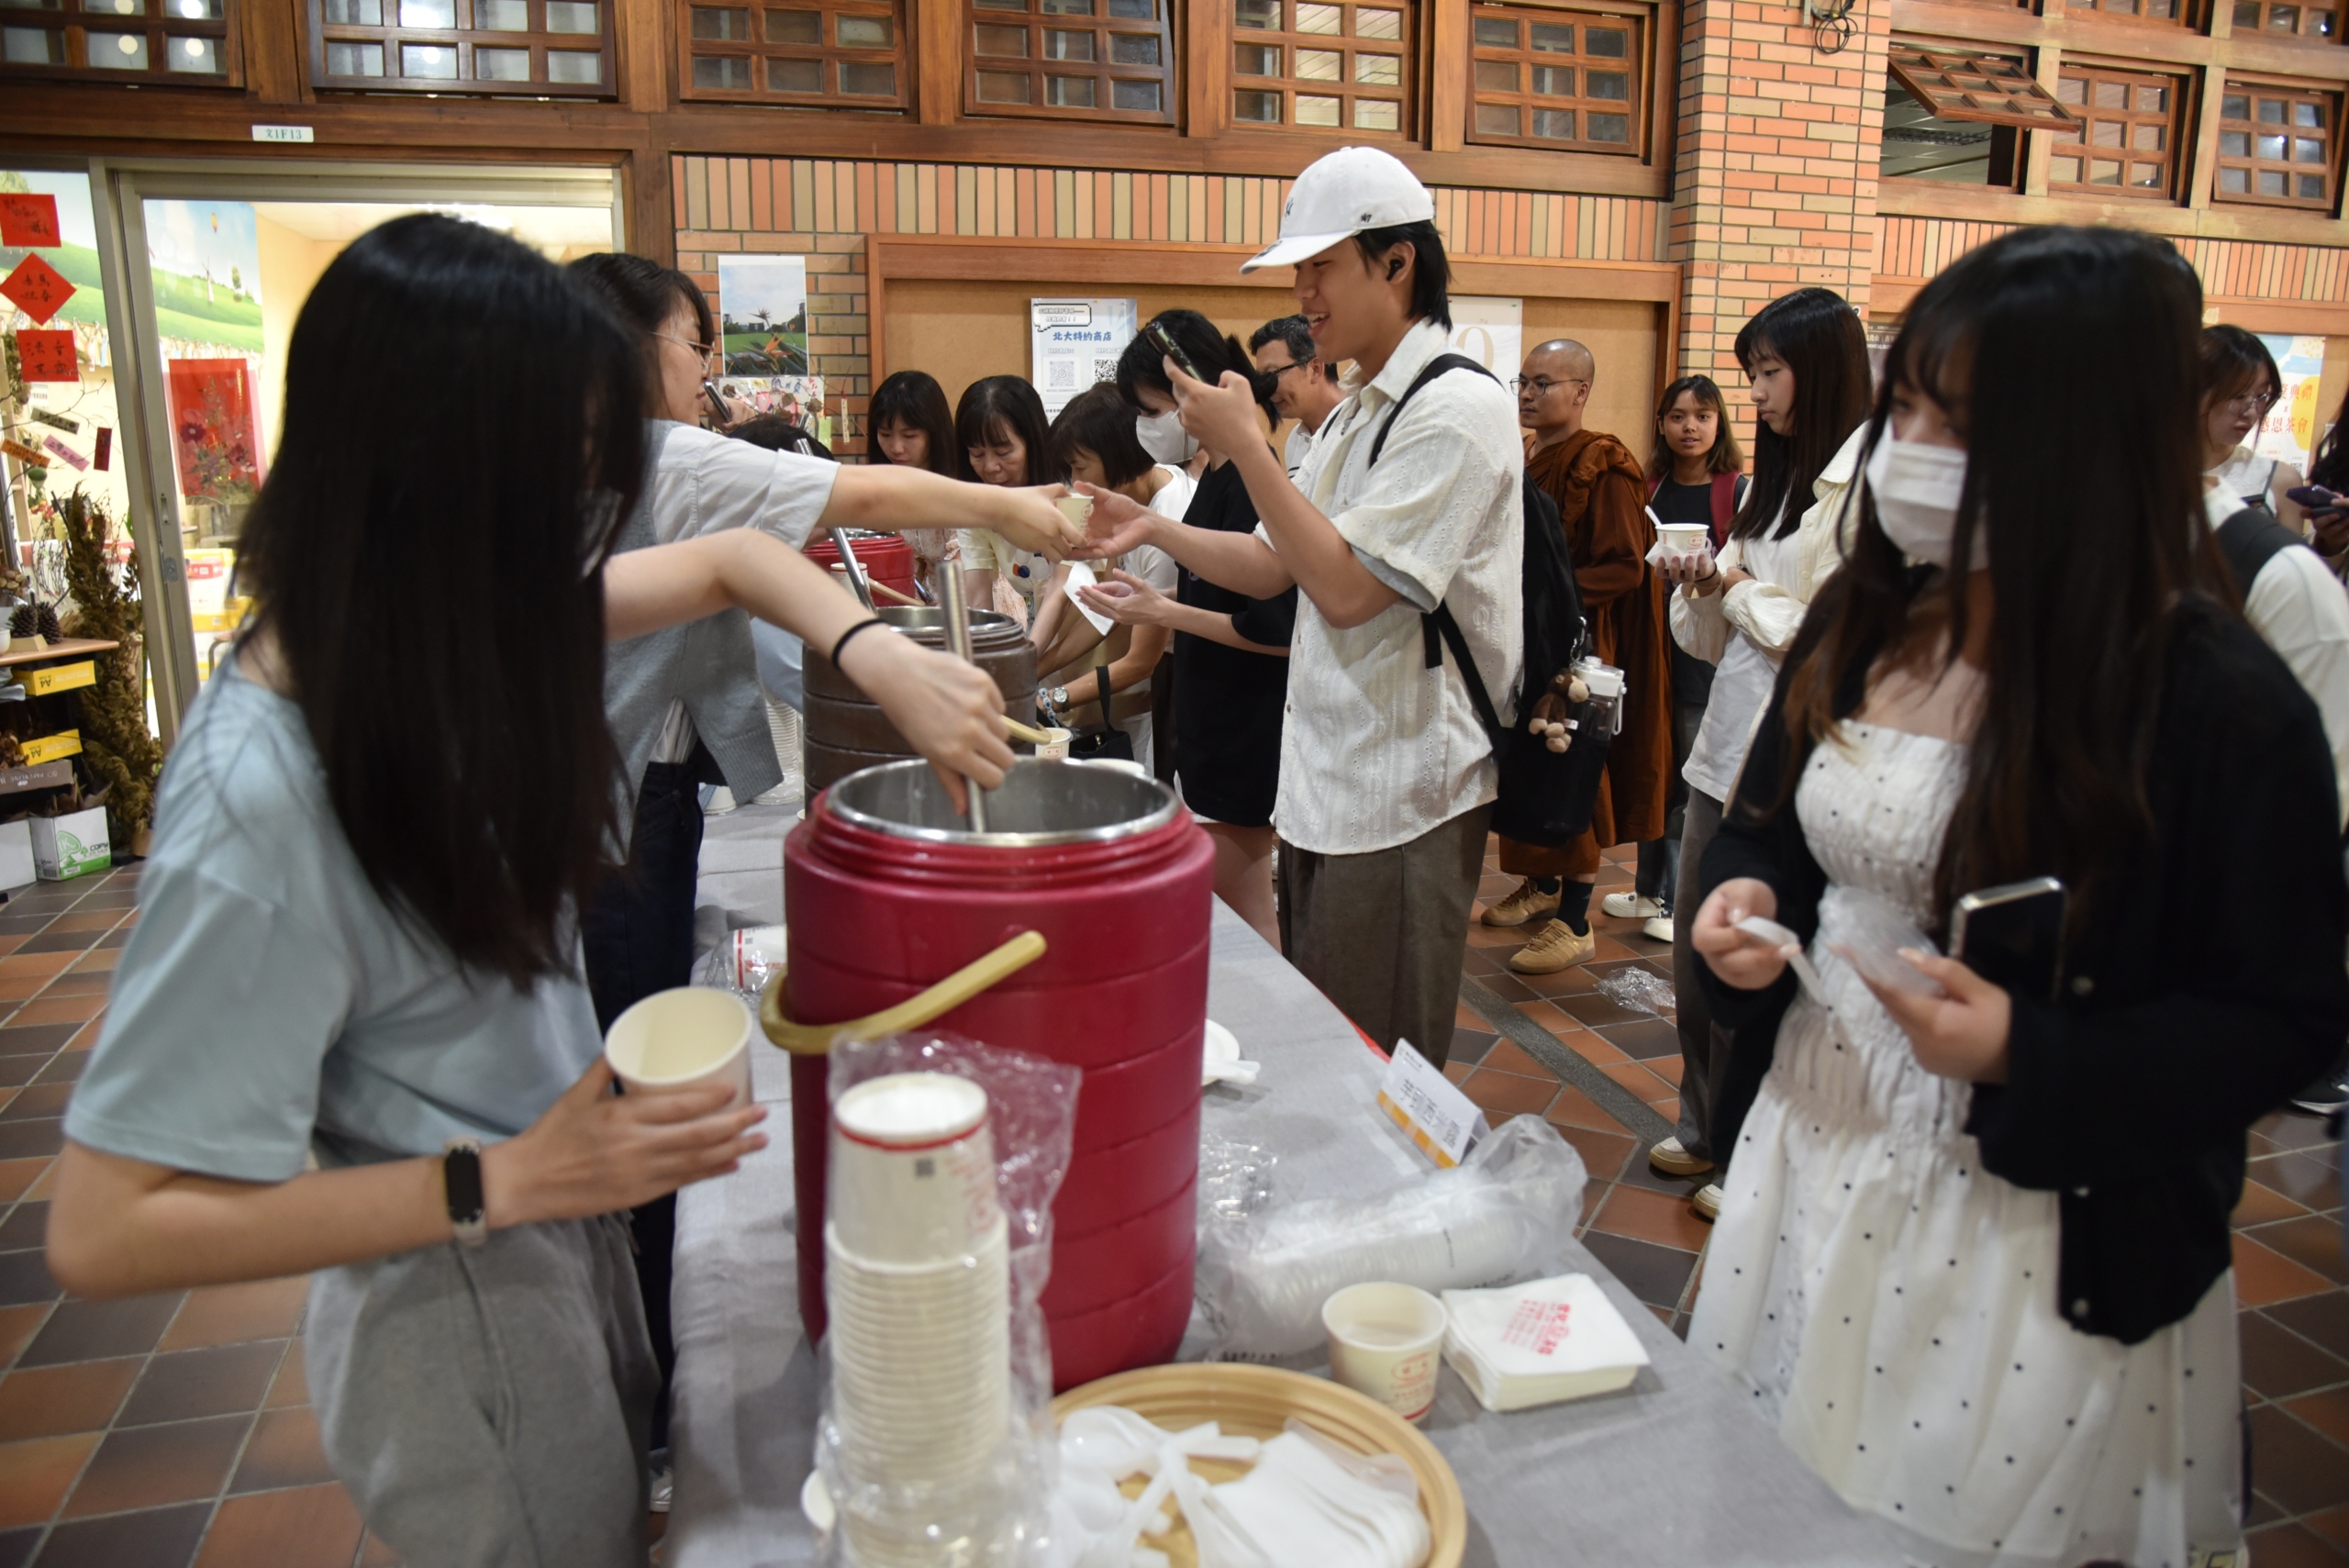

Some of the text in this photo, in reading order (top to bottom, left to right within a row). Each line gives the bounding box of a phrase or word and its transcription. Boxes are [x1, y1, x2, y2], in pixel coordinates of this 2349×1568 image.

[265, 128, 302, 139] 文1F13
[1052, 331, 1112, 341] 北大特約商店
[40, 679, 51, 688] A4
[31, 749, 41, 759] A4
